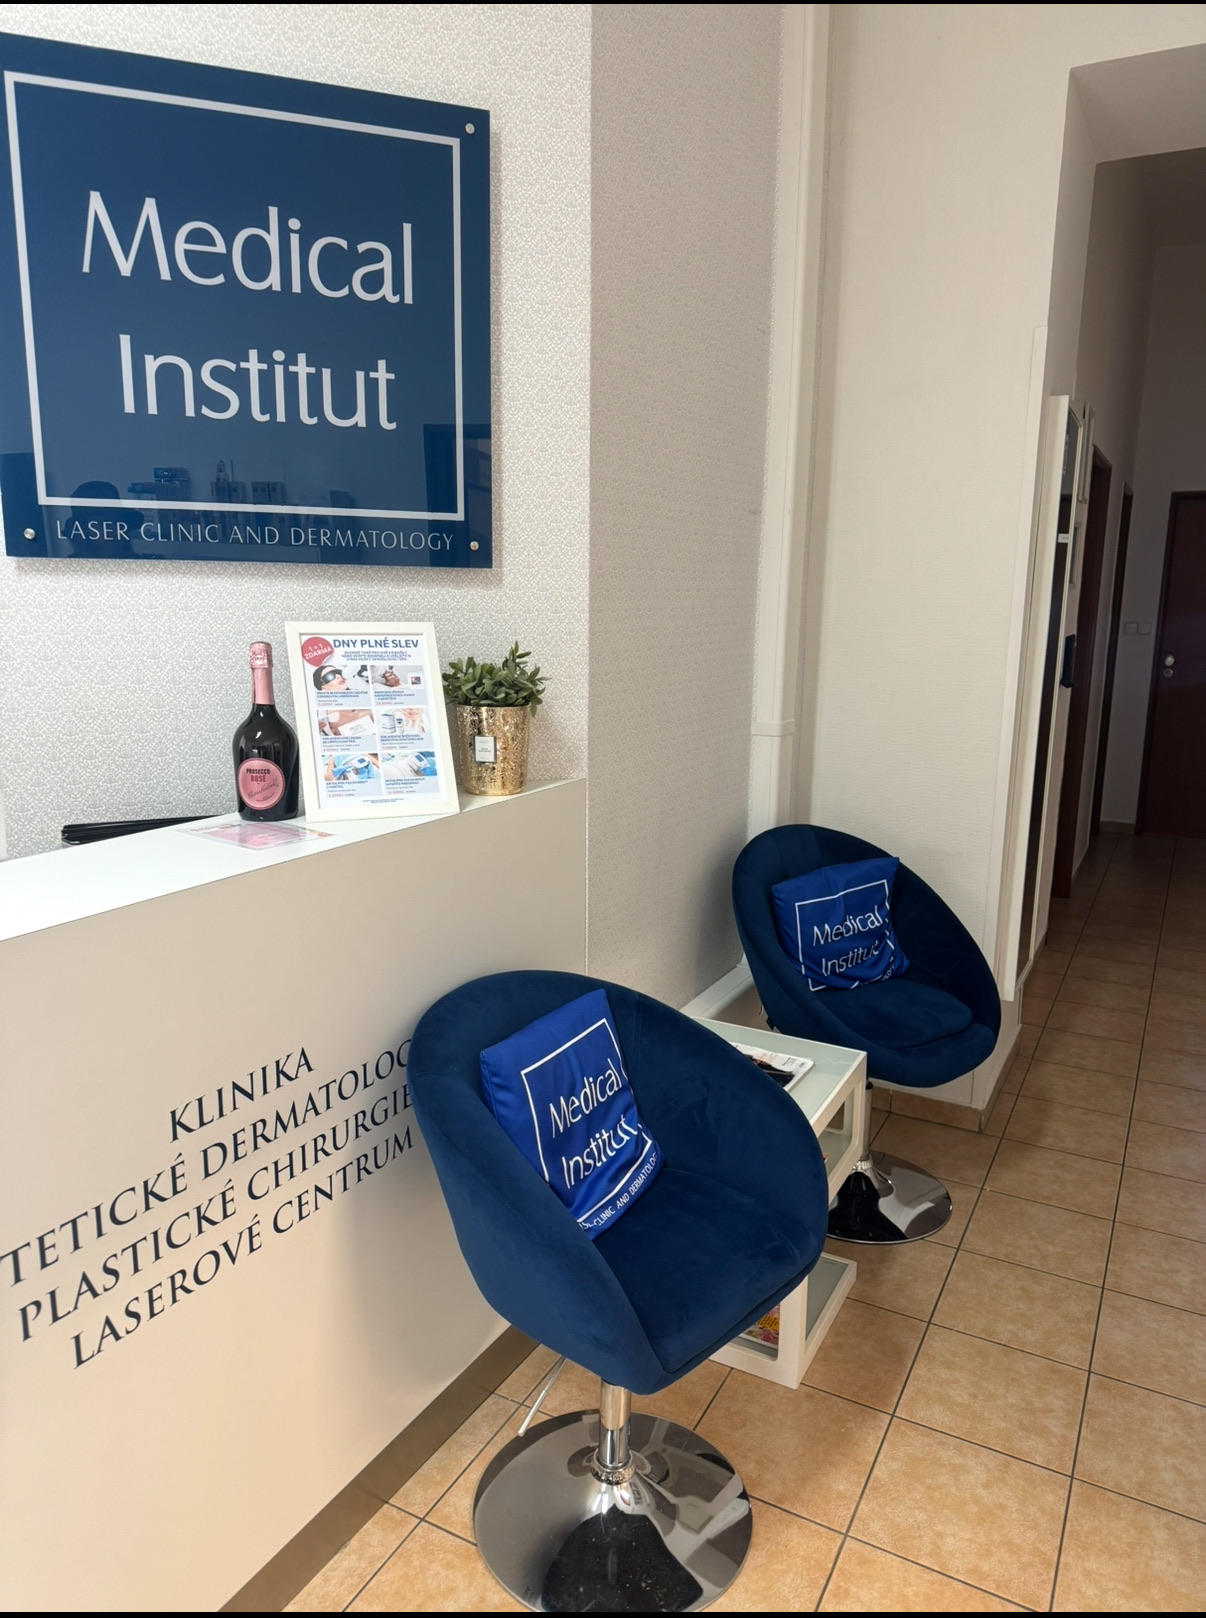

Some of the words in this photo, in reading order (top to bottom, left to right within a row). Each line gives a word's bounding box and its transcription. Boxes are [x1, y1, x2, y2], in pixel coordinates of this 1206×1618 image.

[82, 191, 413, 304] Medical
[119, 334, 397, 430] Institut
[56, 520, 130, 541] LASER
[140, 522, 219, 543] CLINIC
[229, 525, 279, 545] AND
[290, 526, 454, 551] DERMATOLOGY
[304, 646, 332, 659] ZDARMA
[333, 639, 358, 648] DNY
[360, 637, 390, 648] PLNÉ
[391, 639, 419, 648] SLEV
[812, 905, 883, 947] Medical
[169, 1047, 315, 1143] KLINIKA
[549, 1058, 622, 1138] Medical
[561, 1114, 638, 1189] Institut
[0, 1152, 188, 1288] TETICKÉ
[616, 1192, 630, 1209] AND
[18, 1178, 237, 1342] PLASTICKÉ
[70, 1213, 263, 1369] LASEROVÉ
[272, 1125, 414, 1234] CENTRUM
